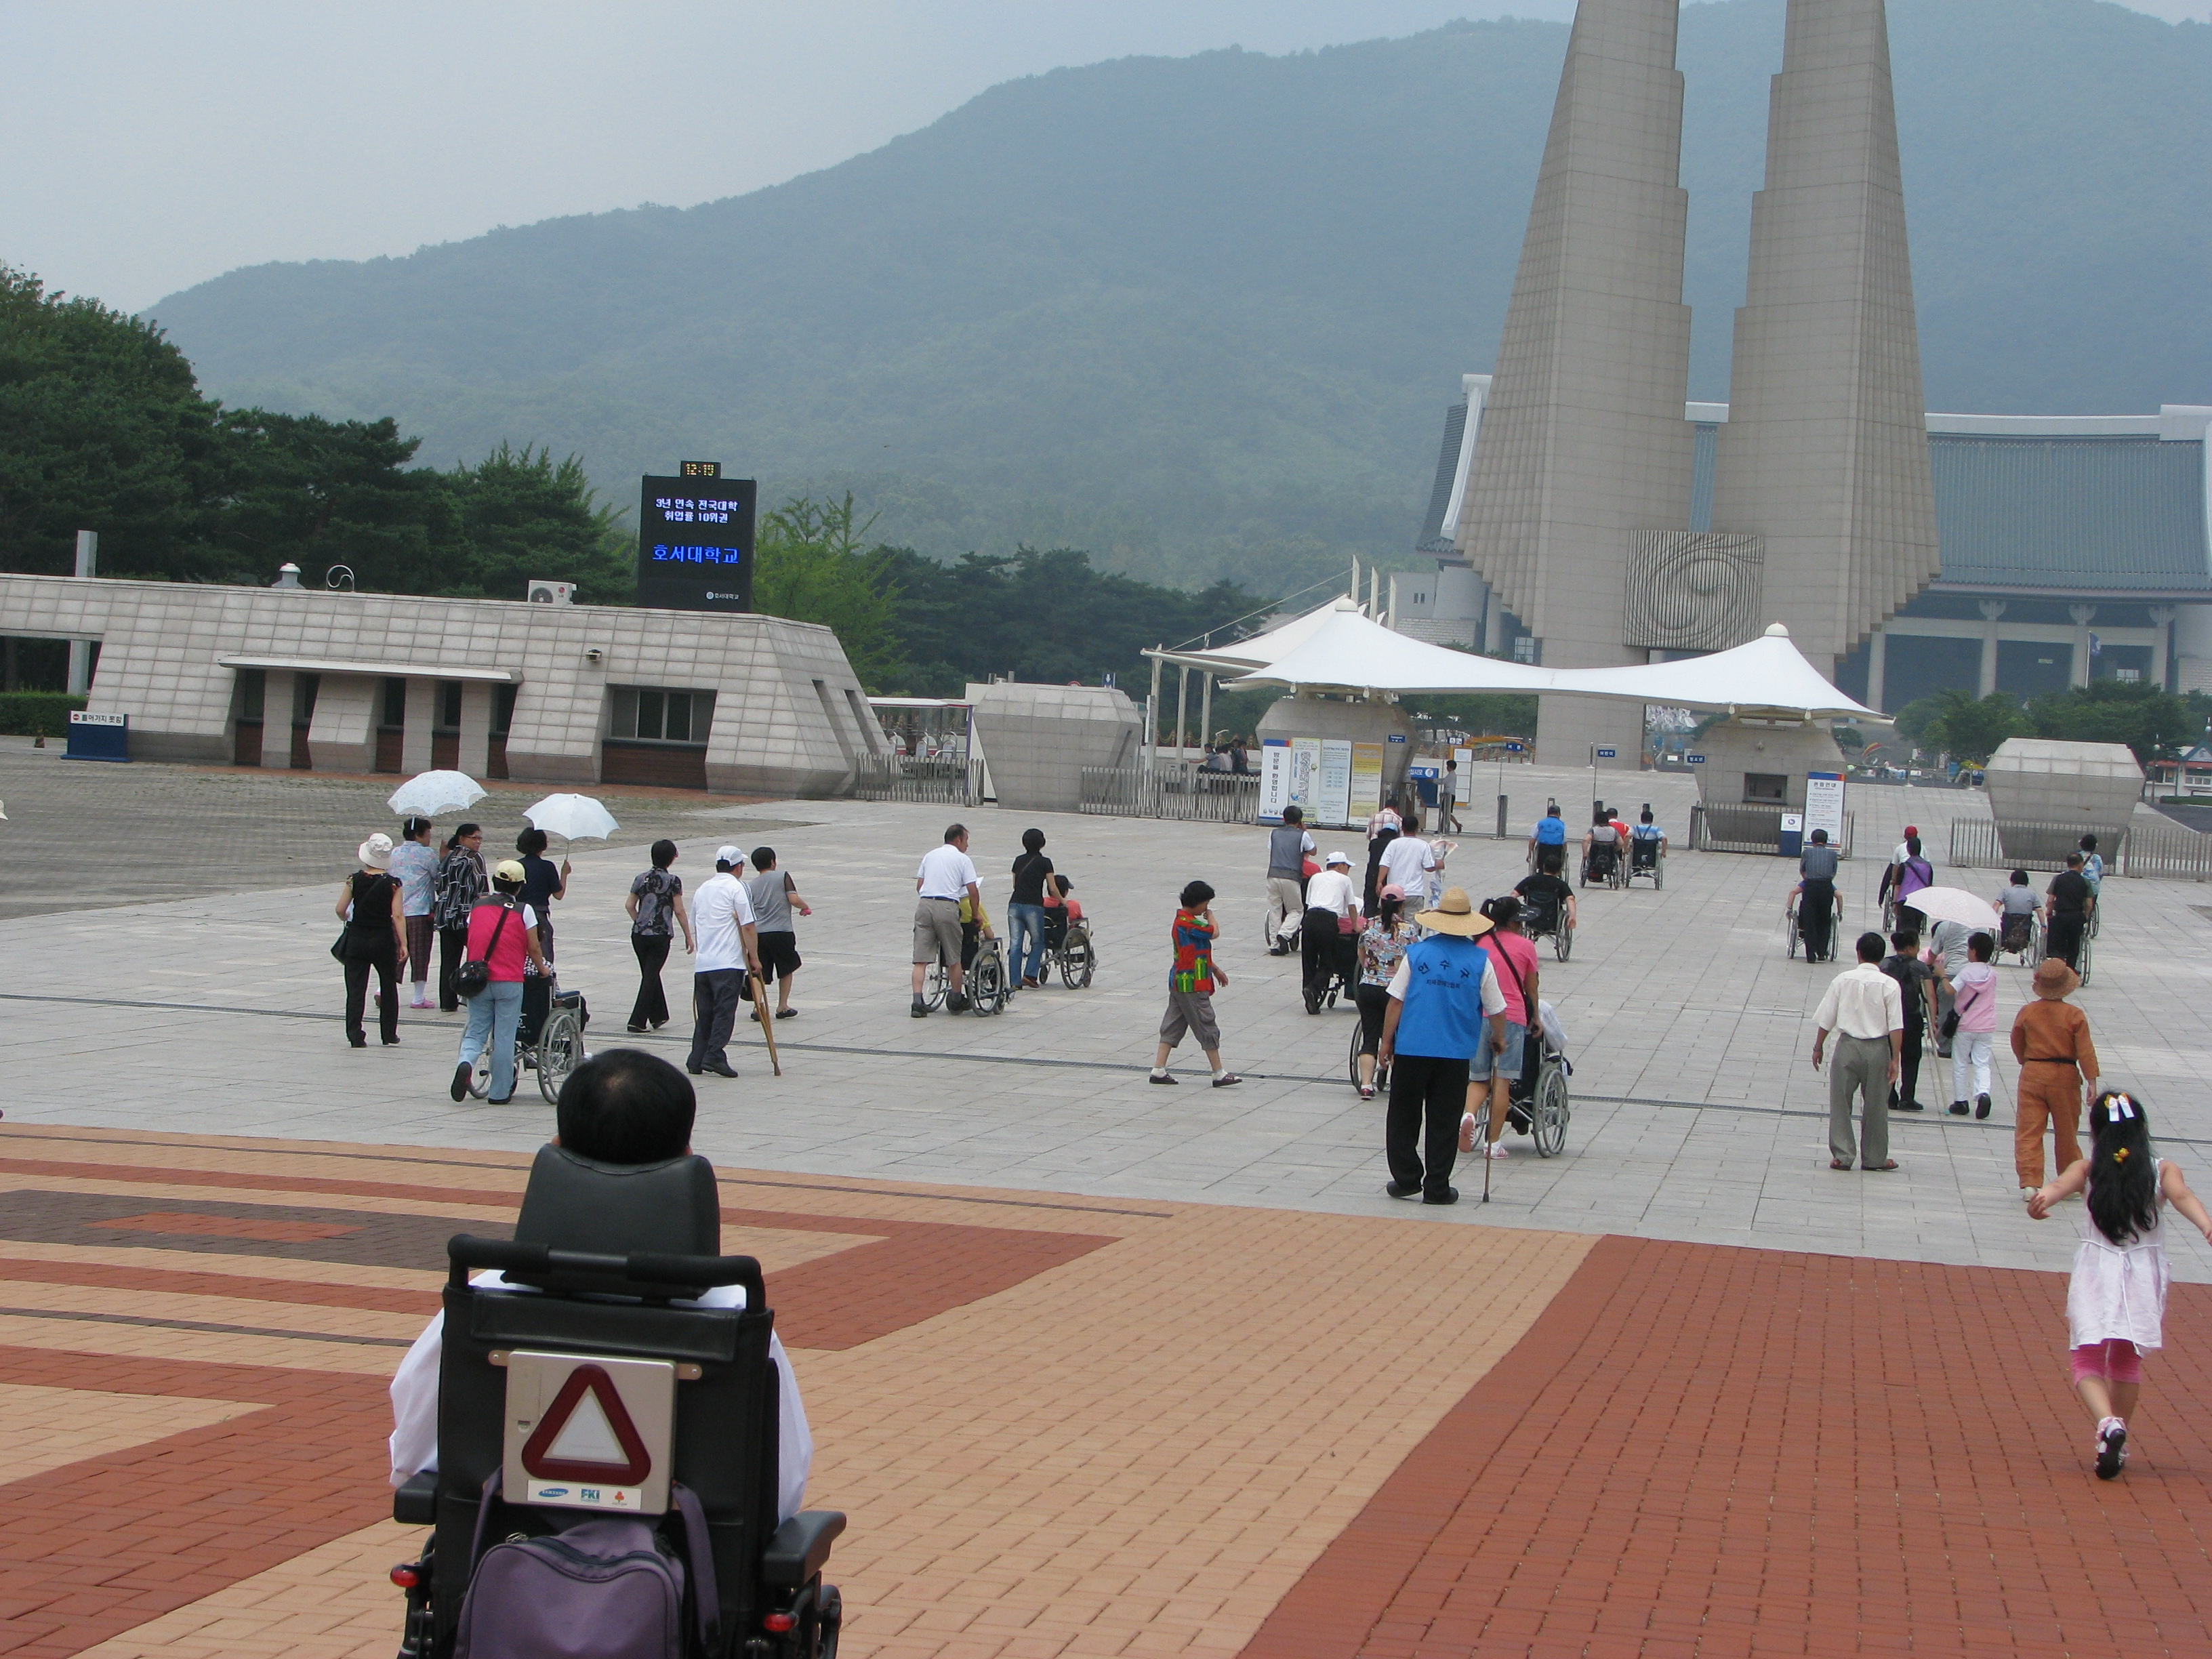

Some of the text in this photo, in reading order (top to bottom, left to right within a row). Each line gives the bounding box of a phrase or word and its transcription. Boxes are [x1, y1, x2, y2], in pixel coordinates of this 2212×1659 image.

[655, 498, 738, 512] 3년 연속 전국대학
[698, 512, 728, 524] 10위권
[652, 544, 739, 565] 호서대학교
[82, 714, 123, 724] 들어가지 못함
[1270, 773, 1279, 804] 환영합니다
[581, 1488, 600, 1499] FKI
